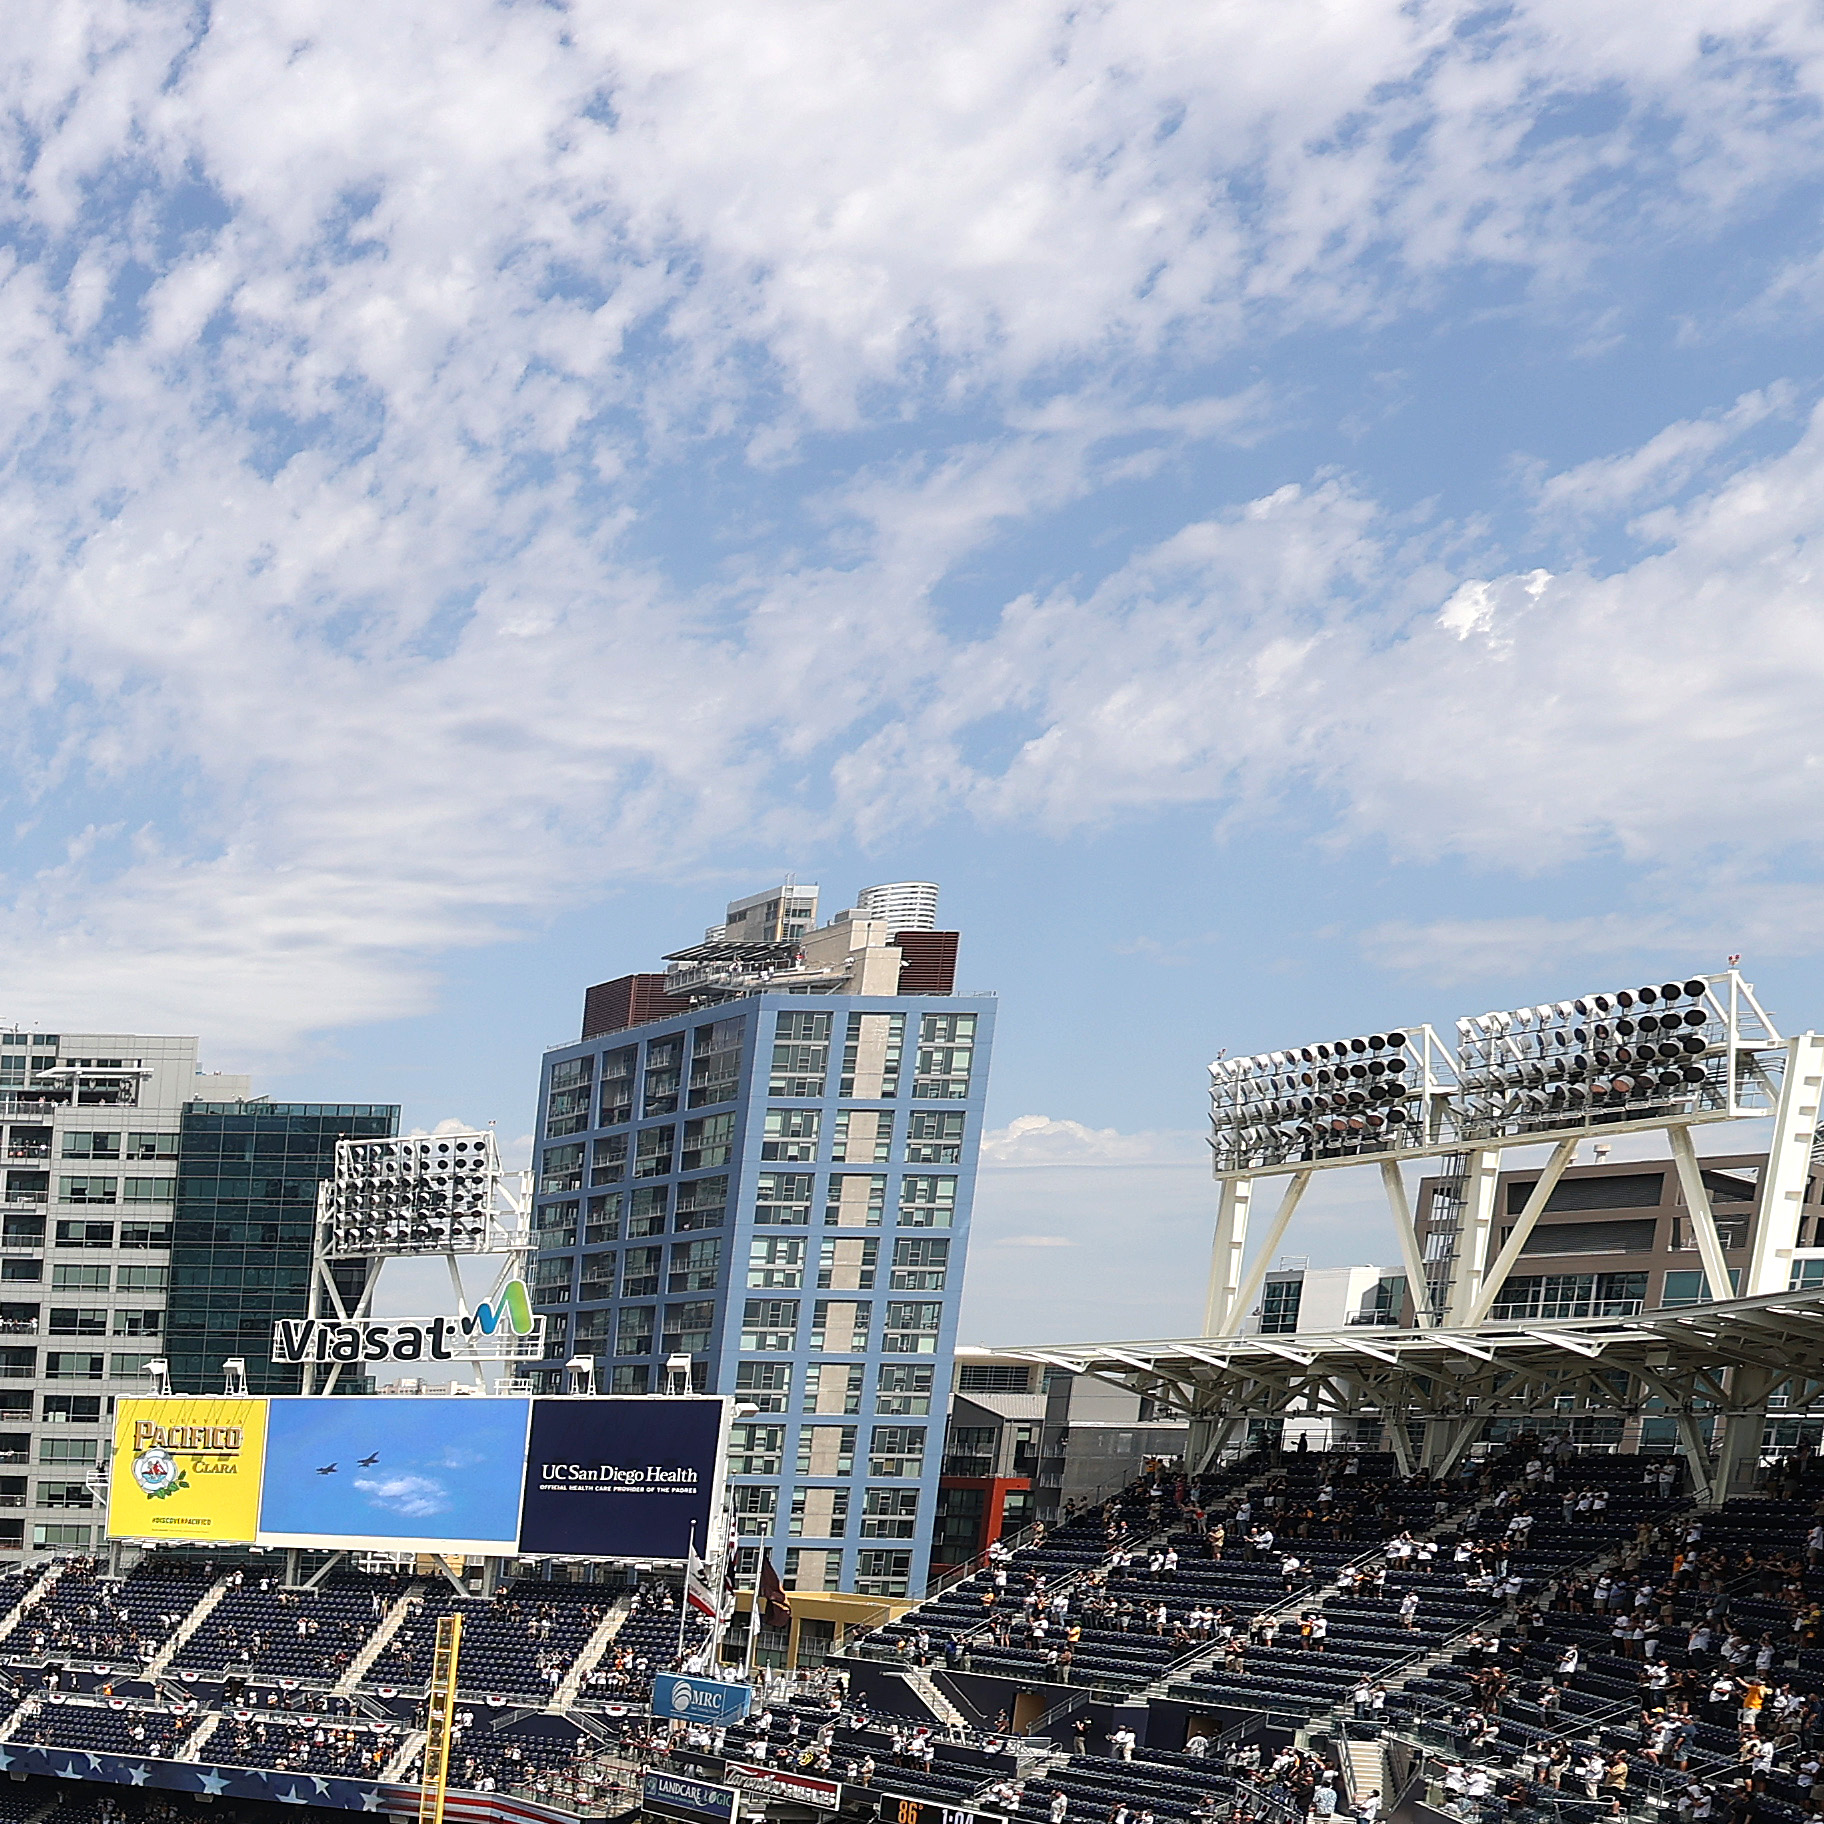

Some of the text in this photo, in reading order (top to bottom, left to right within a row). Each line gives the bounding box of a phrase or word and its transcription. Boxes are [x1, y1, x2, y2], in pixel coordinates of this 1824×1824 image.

[281, 1317, 452, 1362] Viasat
[133, 1420, 243, 1451] PACIFICO
[192, 1461, 238, 1473] CLARA
[542, 1464, 697, 1485] UC San Diego Health
[692, 1690, 722, 1708] MRC
[658, 1778, 702, 1800] LANDCARE
